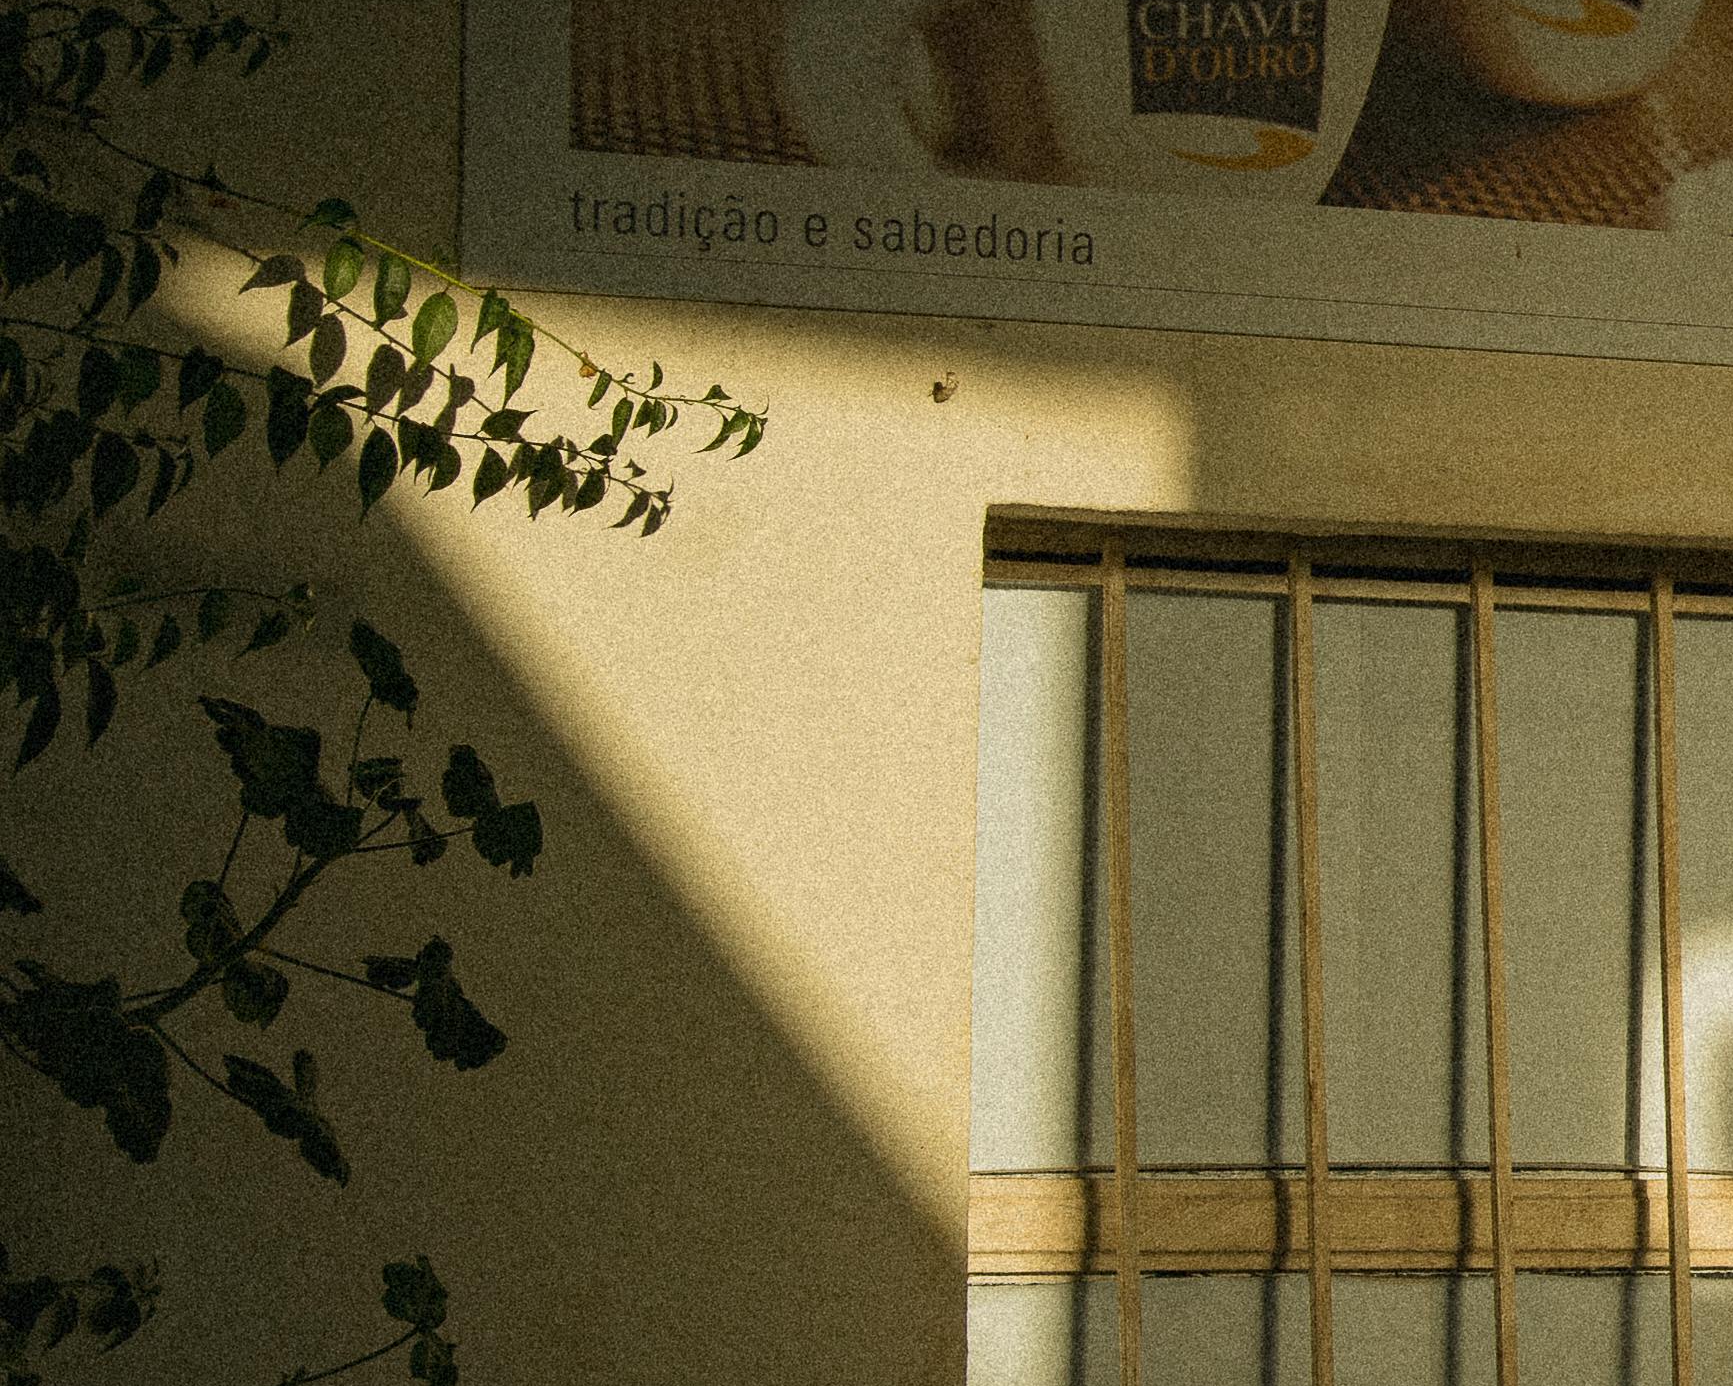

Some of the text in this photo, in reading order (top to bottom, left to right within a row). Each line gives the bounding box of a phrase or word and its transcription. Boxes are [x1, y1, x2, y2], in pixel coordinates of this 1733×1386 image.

[1143, 41, 1318, 84] D'OURO
[569, 189, 1097, 266] tradição e sabedoria
